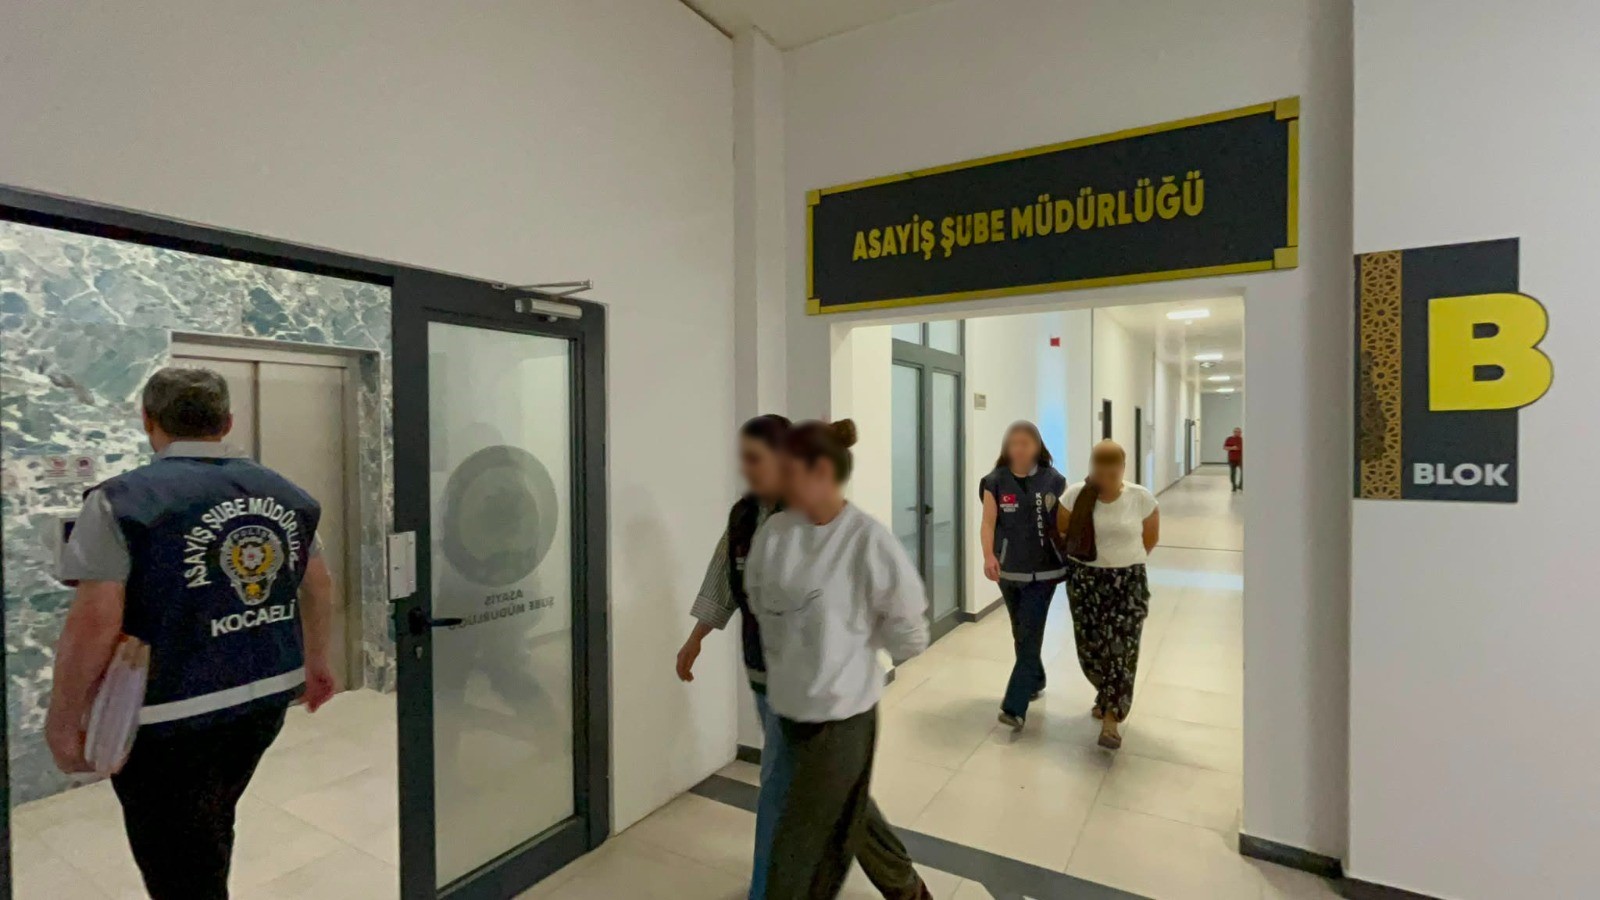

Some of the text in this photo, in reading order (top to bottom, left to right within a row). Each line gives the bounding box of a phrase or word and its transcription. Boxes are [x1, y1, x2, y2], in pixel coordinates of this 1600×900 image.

[853, 171, 1205, 261] ASAYİŞ ŞUBE MÜDÜRLÜĞÜ
[1428, 292, 1554, 411] B
[1413, 463, 1509, 486] BLOK
[184, 526, 217, 588] ASAYİŞ
[202, 498, 248, 531] ŞUBE
[211, 599, 296, 637] KOCAELİ
